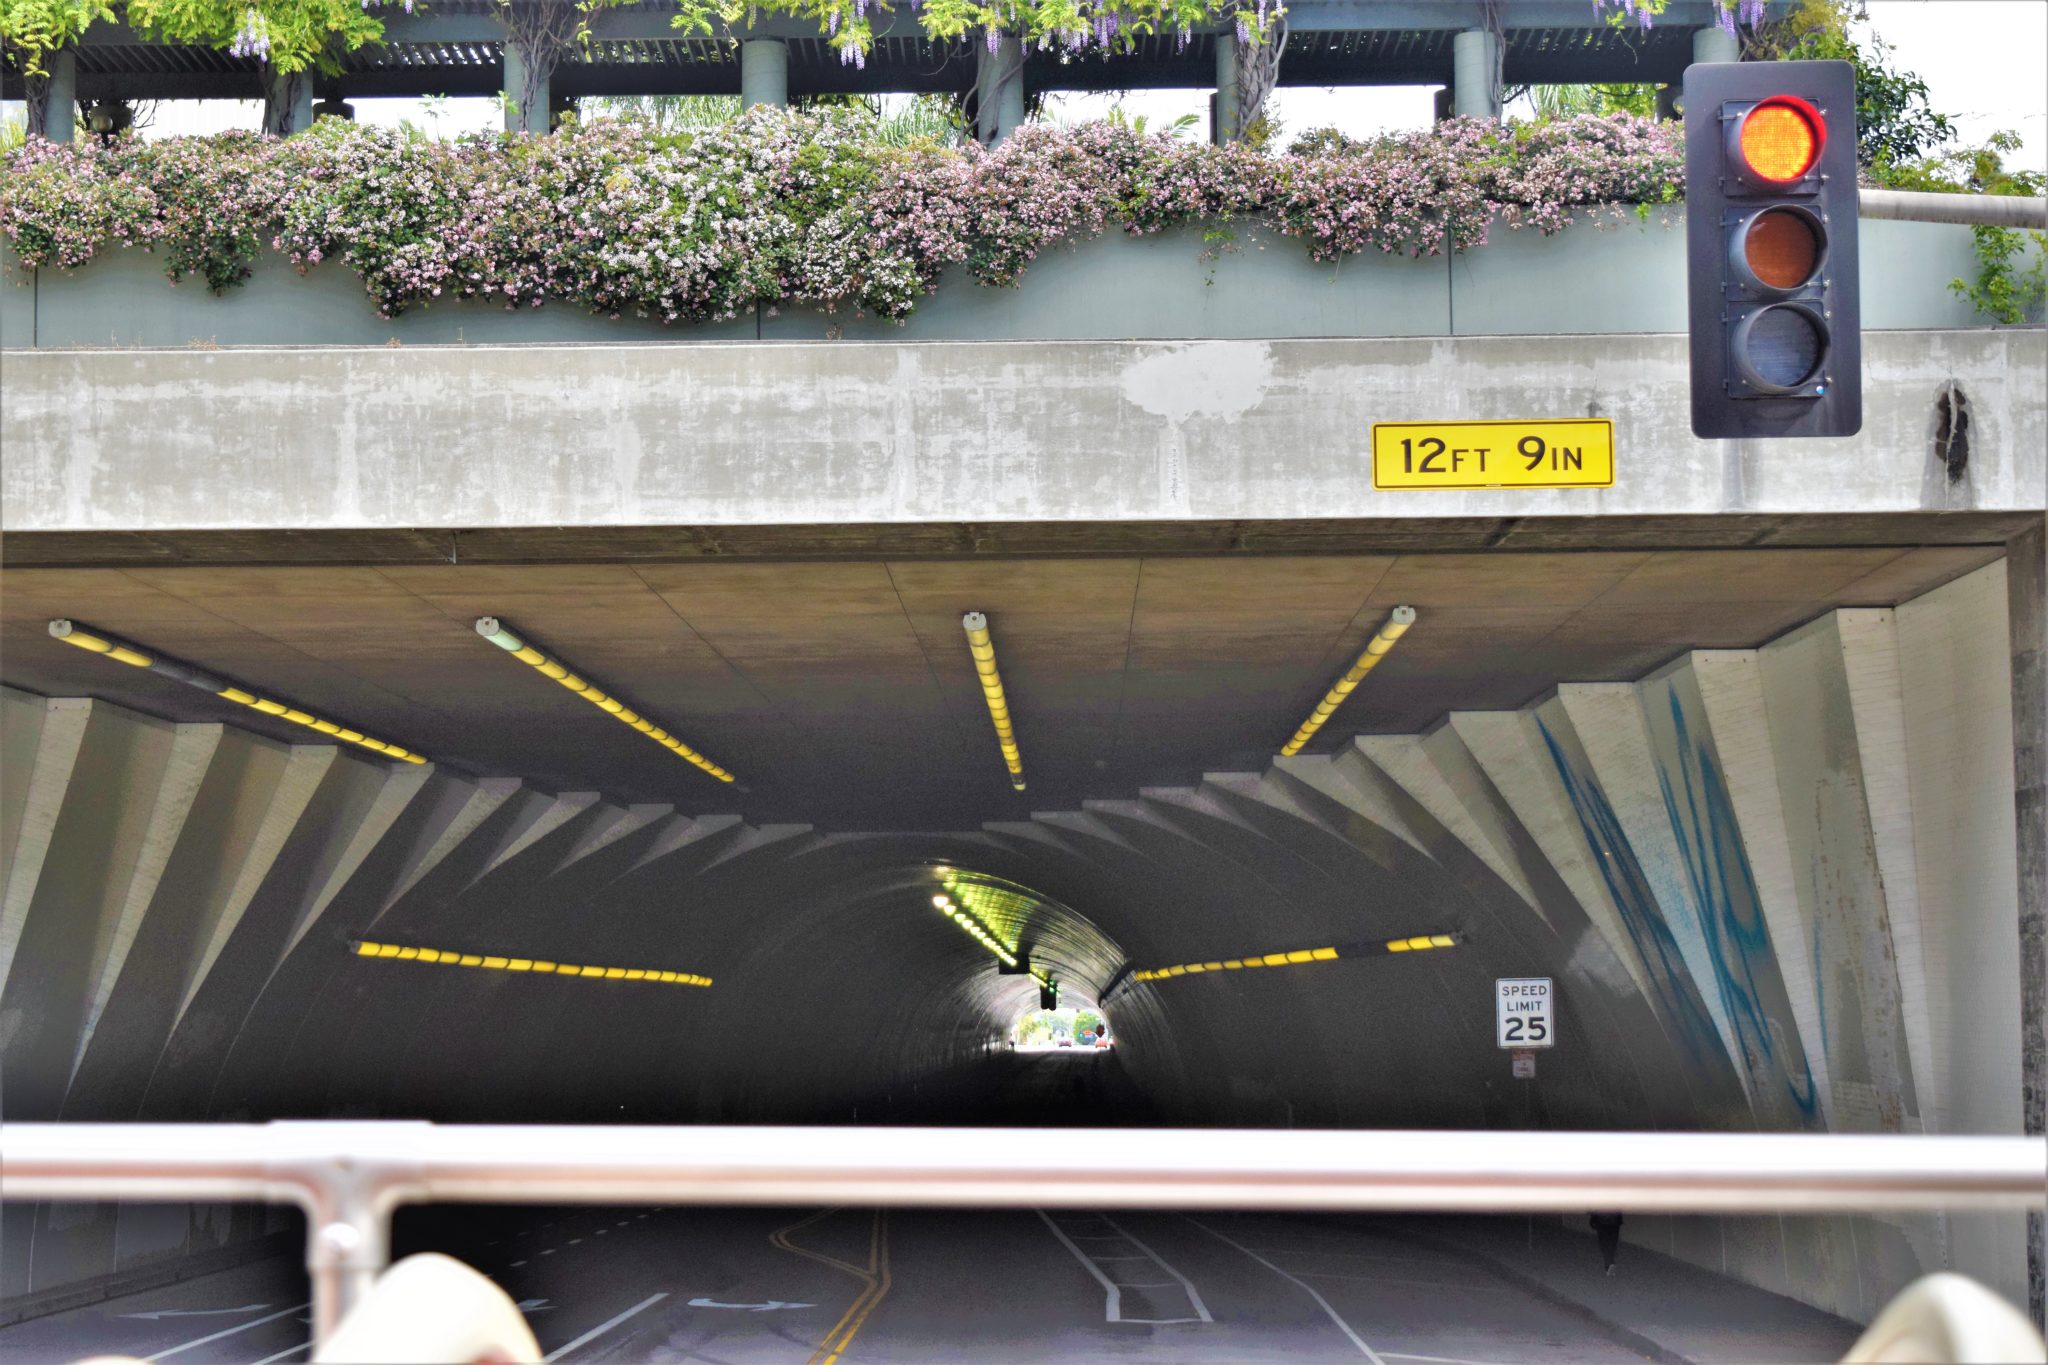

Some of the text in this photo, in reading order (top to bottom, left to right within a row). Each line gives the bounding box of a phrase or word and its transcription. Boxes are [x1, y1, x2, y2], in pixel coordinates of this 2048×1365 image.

[1502, 985, 1547, 997] SPEED
[1507, 1001, 1542, 1012] LIMIT
[1505, 1016, 1547, 1041] 25
